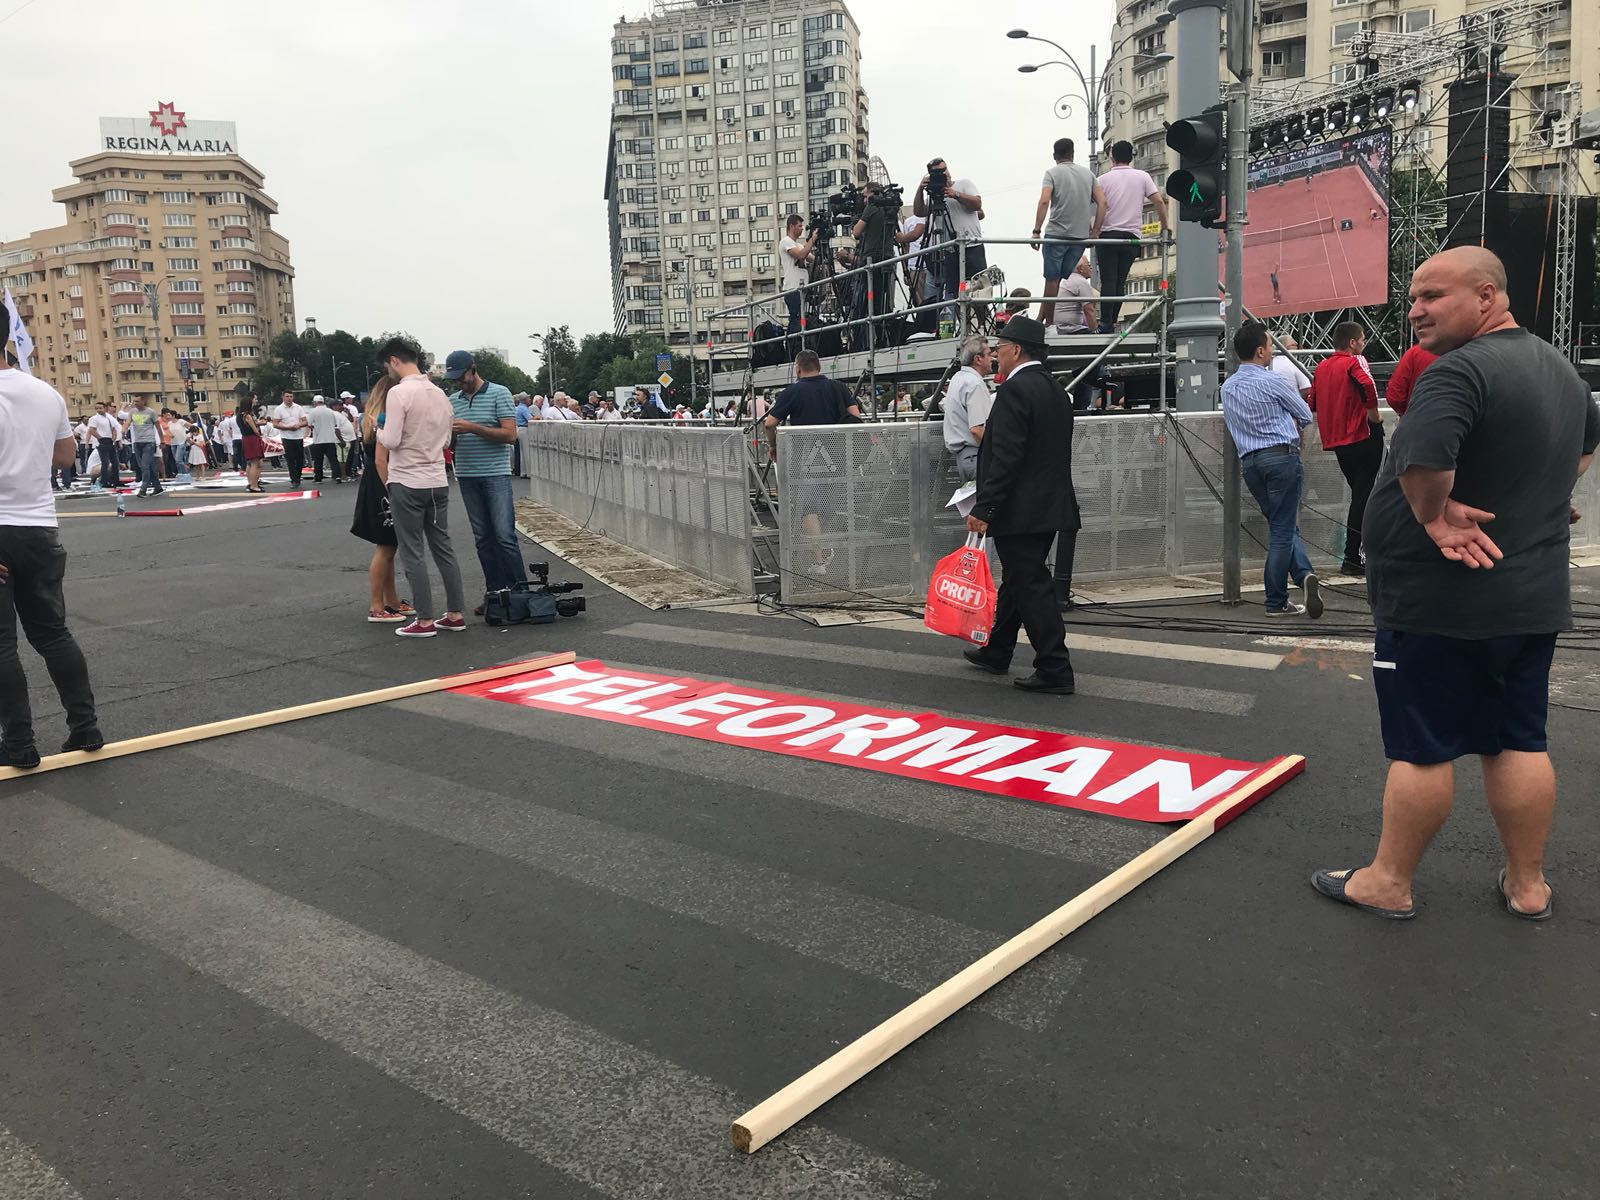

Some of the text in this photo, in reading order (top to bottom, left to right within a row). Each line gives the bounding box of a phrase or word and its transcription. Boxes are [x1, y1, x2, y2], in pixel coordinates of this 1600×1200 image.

[106, 137, 233, 152] REGINA MARIA
[1268, 161, 1308, 176] BNP PARIBAS
[940, 579, 981, 605] PROFI
[488, 664, 1258, 812] TELEORMAN
